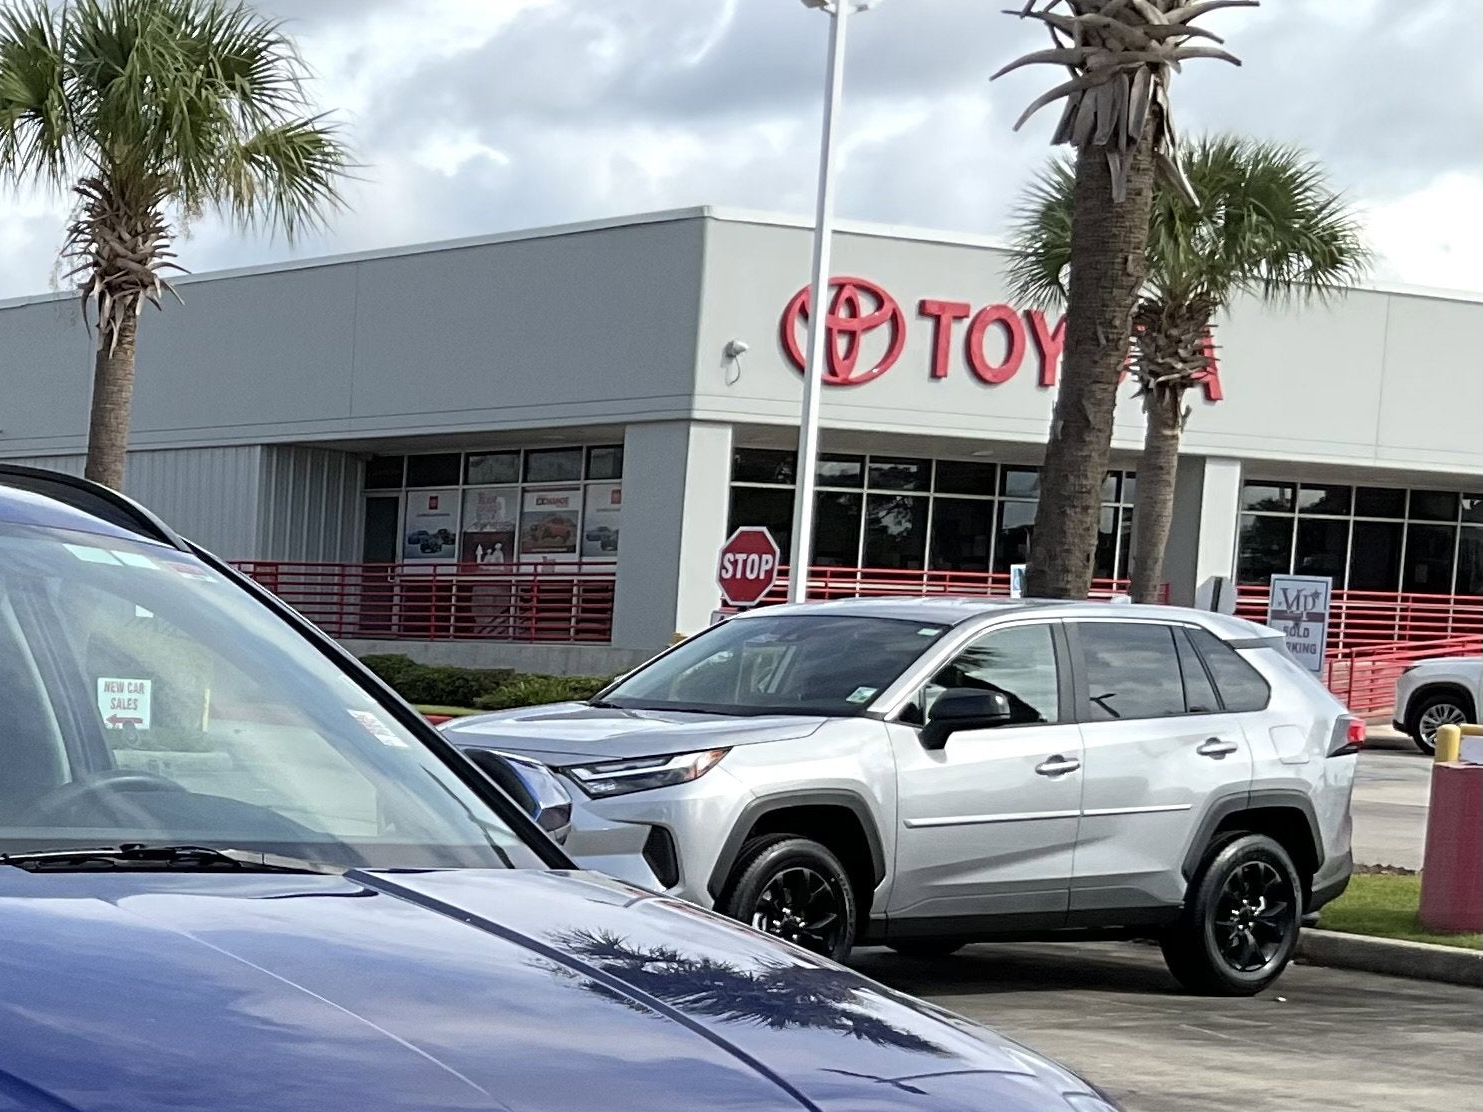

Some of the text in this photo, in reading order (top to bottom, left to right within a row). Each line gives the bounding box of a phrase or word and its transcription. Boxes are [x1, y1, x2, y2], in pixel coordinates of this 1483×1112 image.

[721, 553, 773, 580] STOP
[1283, 625, 1310, 638] SOLD
[1286, 641, 1317, 654] RKING
[103, 681, 145, 694] NEW CAR
[110, 697, 138, 710] SALES
